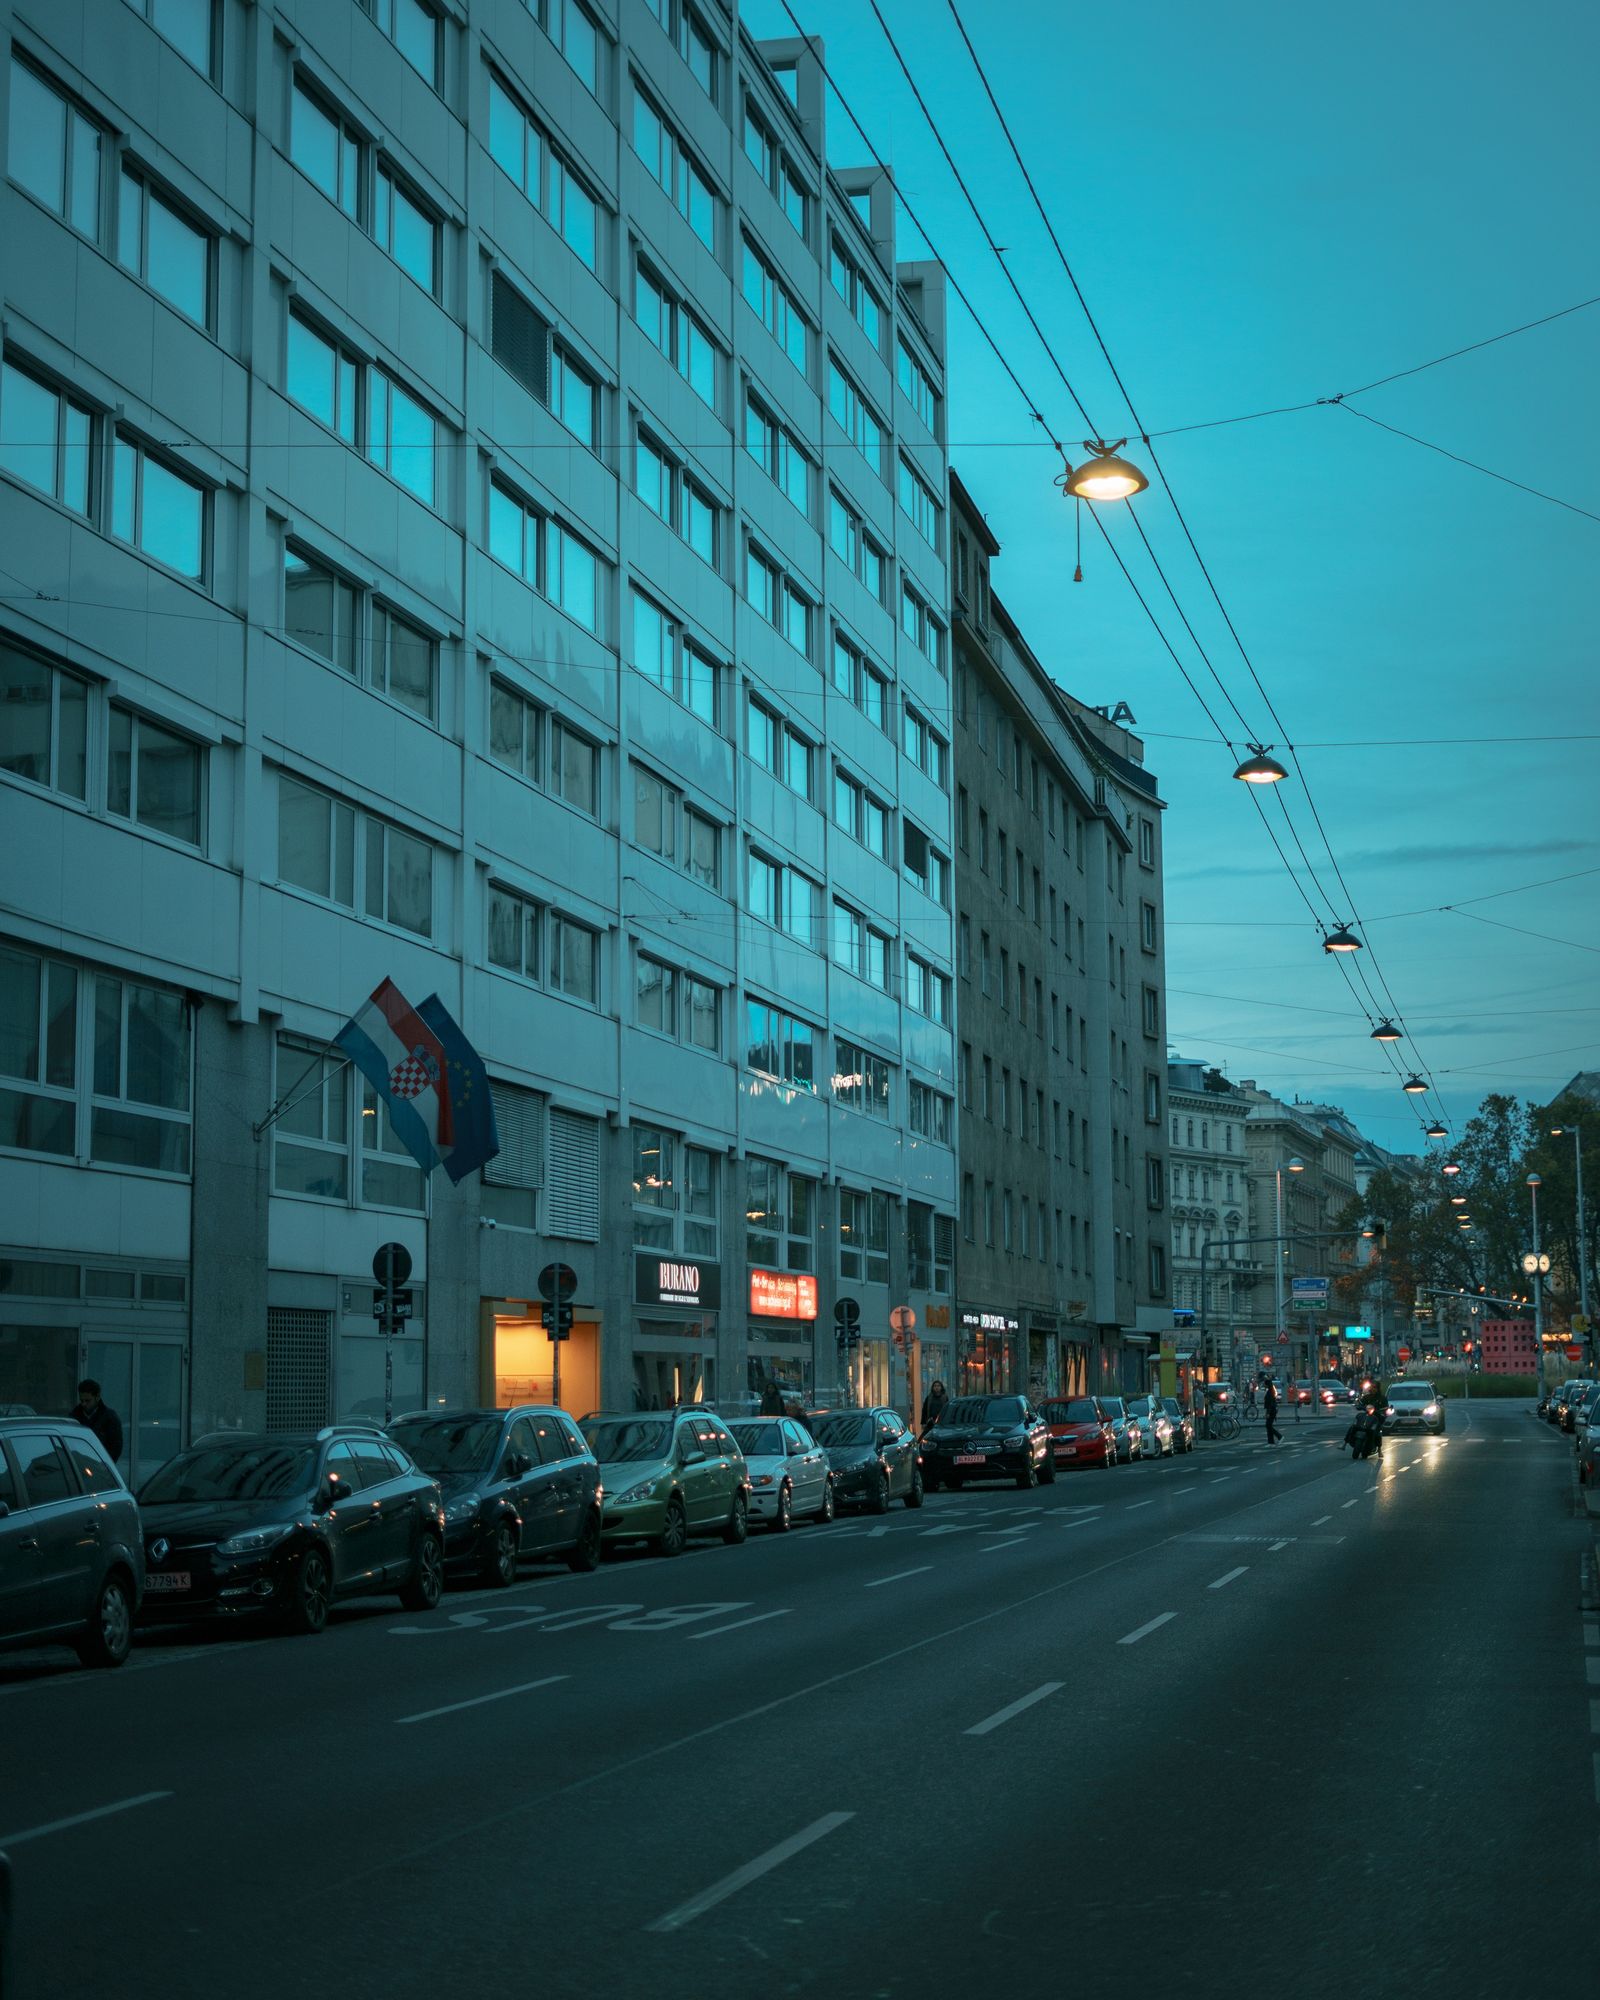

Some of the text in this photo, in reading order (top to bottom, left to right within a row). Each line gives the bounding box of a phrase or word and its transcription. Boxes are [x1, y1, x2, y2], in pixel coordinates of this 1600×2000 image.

[660, 1262, 699, 1292] BURANO
[922, 1505, 1104, 1517] BUS
[796, 1523, 1042, 1538] TAXI
[387, 1602, 756, 1635] BUS
